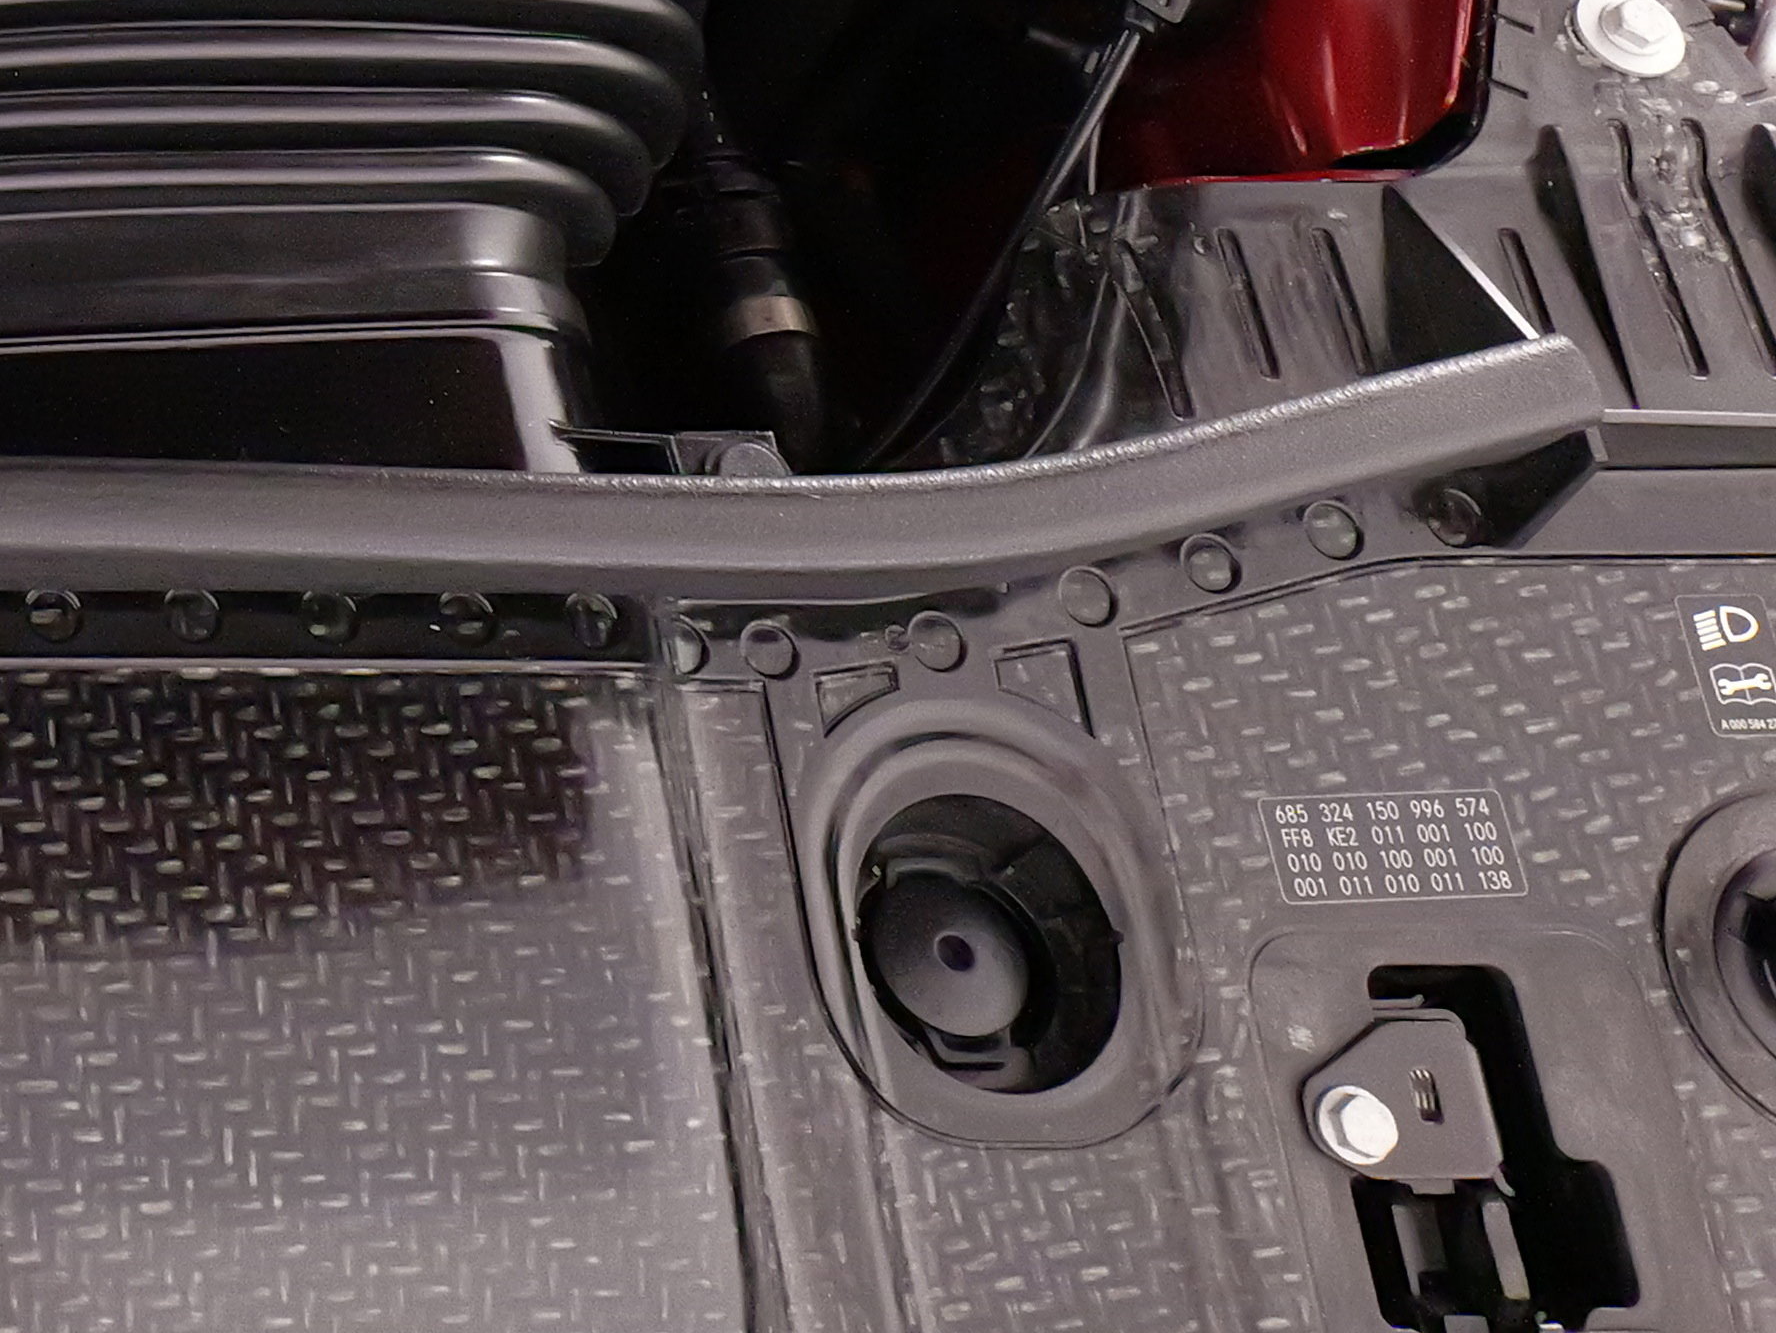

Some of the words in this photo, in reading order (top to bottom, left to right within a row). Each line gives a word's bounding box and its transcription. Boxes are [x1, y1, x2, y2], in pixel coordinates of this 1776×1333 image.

[1276, 804, 1308, 824] 685
[1319, 803, 1353, 822] 324
[1367, 801, 1399, 820] 150
[1410, 799, 1444, 818] 996
[1456, 798, 1489, 816] 574
[1282, 828, 1313, 848] FF8
[1327, 827, 1358, 847] KE2
[1371, 826, 1404, 845] 011
[1417, 824, 1450, 843] 001
[1464, 822, 1496, 841] 100
[1287, 853, 1321, 872] 010
[1333, 852, 1367, 871] 010
[1380, 850, 1412, 869] 100
[1424, 848, 1457, 867] 001
[1471, 846, 1504, 865] 100
[1294, 878, 1328, 897] 001
[1340, 876, 1373, 895] 011
[1385, 874, 1420, 893] 010
[1431, 873, 1464, 892] 011
[1479, 870, 1512, 890] 138
